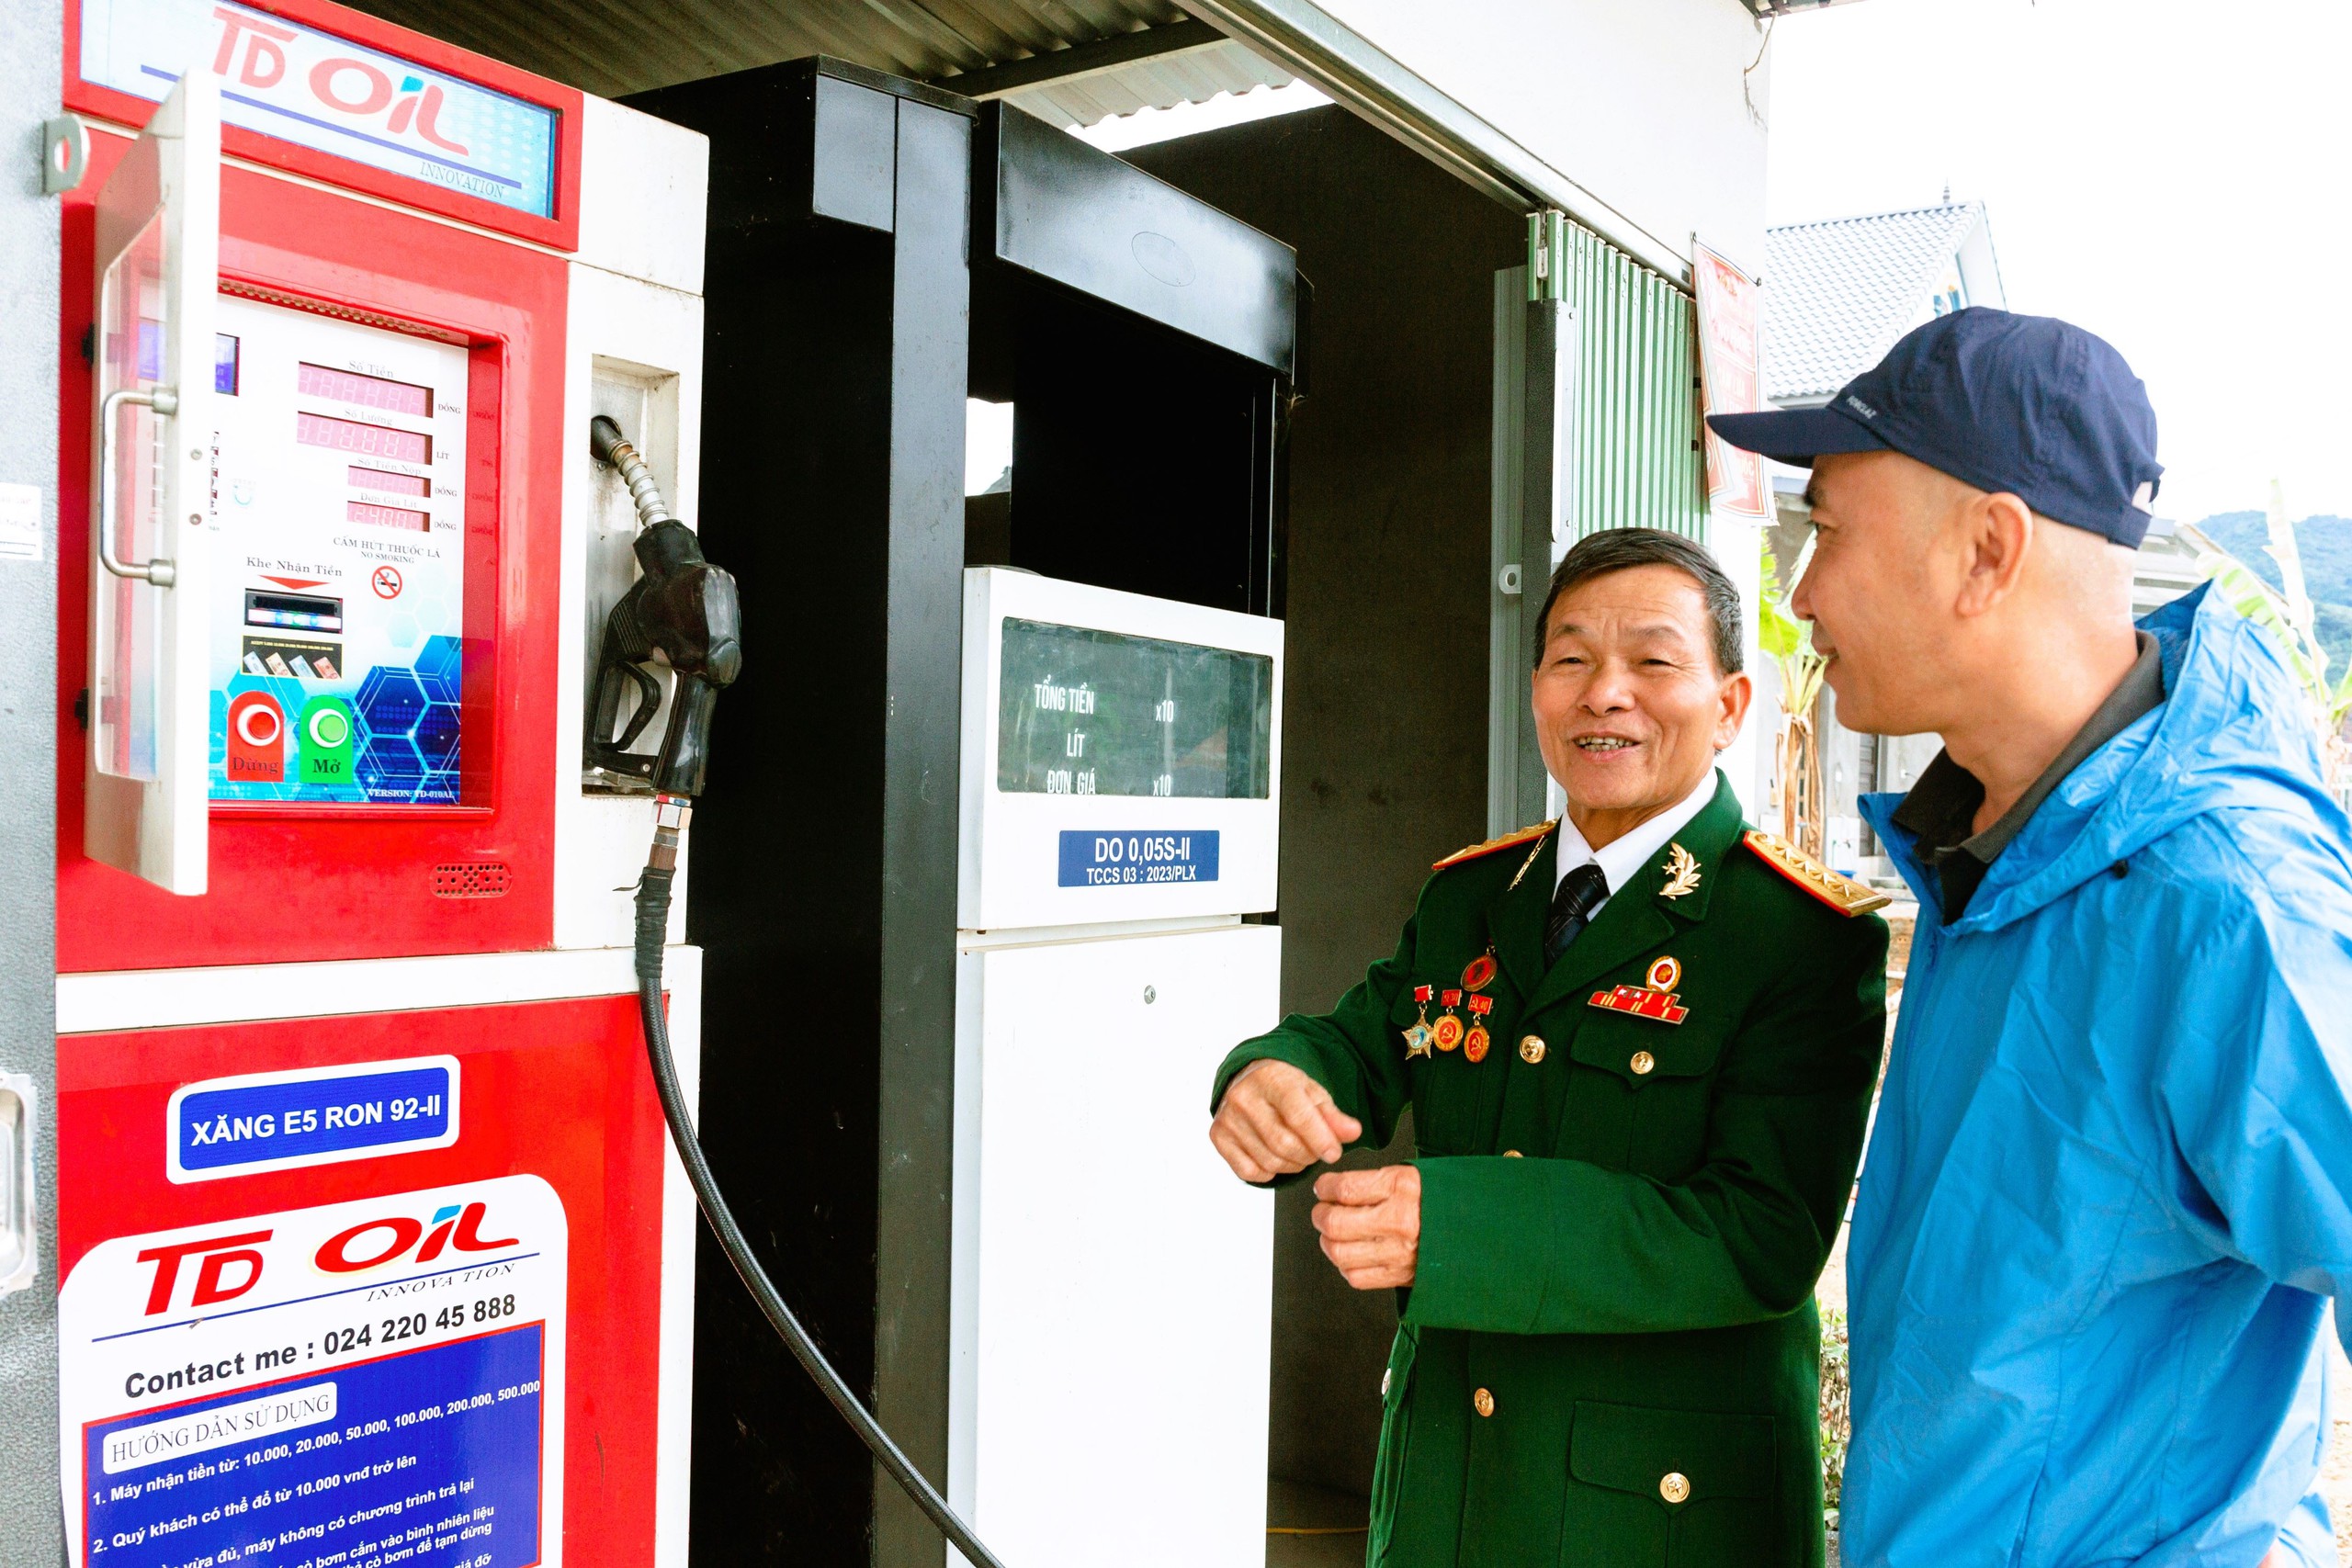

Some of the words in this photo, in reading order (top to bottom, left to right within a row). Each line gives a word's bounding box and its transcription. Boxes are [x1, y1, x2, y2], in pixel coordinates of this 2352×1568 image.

[211, 7, 300, 88] TD
[420, 161, 505, 198] INNOVATION
[436, 450, 450, 460] LÍT
[246, 557, 273, 570] Khe
[277, 560, 311, 574] Nhận
[361, 551, 374, 559] NO
[375, 553, 415, 564] SMOKING
[1035, 674, 1066, 711] TỔNG
[1069, 682, 1095, 715] TIỀN
[1155, 700, 1174, 723] x10
[1067, 728, 1085, 757] LÍT
[313, 757, 341, 774] Mở
[1047, 769, 1072, 795] ĐƠN
[1077, 768, 1096, 795] GIÁ
[368, 789, 413, 798] VERSION:
[1153, 774, 1171, 796] x10
[1095, 837, 1124, 863] DO
[1128, 837, 1190, 866] 0,05S-II
[1087, 867, 1120, 885] TCCS
[1124, 867, 1136, 883] 03
[1147, 865, 1196, 883] 2023/PLX
[191, 1114, 275, 1146] XĂNG
[284, 1110, 317, 1134] E5
[325, 1101, 382, 1130] RON
[390, 1095, 440, 1121] 92-II
[136, 1229, 273, 1316] TD
[125, 1354, 243, 1399] Contact
[255, 1345, 297, 1371] me
[323, 1324, 372, 1356] 024
[380, 1313, 427, 1345] 220
[435, 1303, 466, 1330] 45
[473, 1293, 516, 1324] 888
[93, 1492, 106, 1506] 1.
[110, 1483, 142, 1502] Máy
[146, 1472, 184, 1492] nhận
[187, 1462, 215, 1482] tiền
[219, 1458, 240, 1473] từ:
[244, 1445, 292, 1467] 10.000,
[296, 1431, 343, 1454] 20.000,
[345, 1419, 391, 1441] 50.000,
[394, 1405, 445, 1429] 100.000,
[447, 1393, 495, 1416] 200.000,
[498, 1380, 540, 1402] 500.000
[111, 1428, 189, 1463] HƯỚNG
[244, 1404, 271, 1430] SỬ
[276, 1394, 330, 1424] DỤNG
[94, 1539, 107, 1554] 2.
[112, 1527, 146, 1548] Quý
[150, 1514, 198, 1538] khách
[202, 1506, 220, 1524] có
[224, 1496, 249, 1517] thể
[252, 1490, 272, 1509] đổ
[275, 1488, 292, 1504] từ
[295, 1474, 341, 1497] 10.000
[344, 1466, 370, 1484] vnđ
[372, 1461, 394, 1477] trở
[397, 1455, 417, 1471] lên
[217, 1547, 241, 1564] đủ,
[245, 1538, 277, 1556] máy
[280, 1524, 324, 1546] không
[328, 1517, 345, 1531] có
[348, 1501, 402, 1525] chương
[406, 1490, 436, 1509] trình
[439, 1483, 457, 1499] trả
[459, 1478, 475, 1495] lại
[316, 1551, 347, 1568] bơm
[350, 1540, 378, 1558] cắm
[380, 1534, 403, 1551] vào
[406, 1524, 434, 1540] bình
[436, 1514, 470, 1533] nhiên
[473, 1506, 495, 1521] liệu
[385, 1547, 414, 1564] bơm
[416, 1537, 433, 1554] để
[435, 1534, 458, 1550] tạm
[460, 1522, 492, 1540] dừng
[474, 1552, 492, 1568] đỡ
